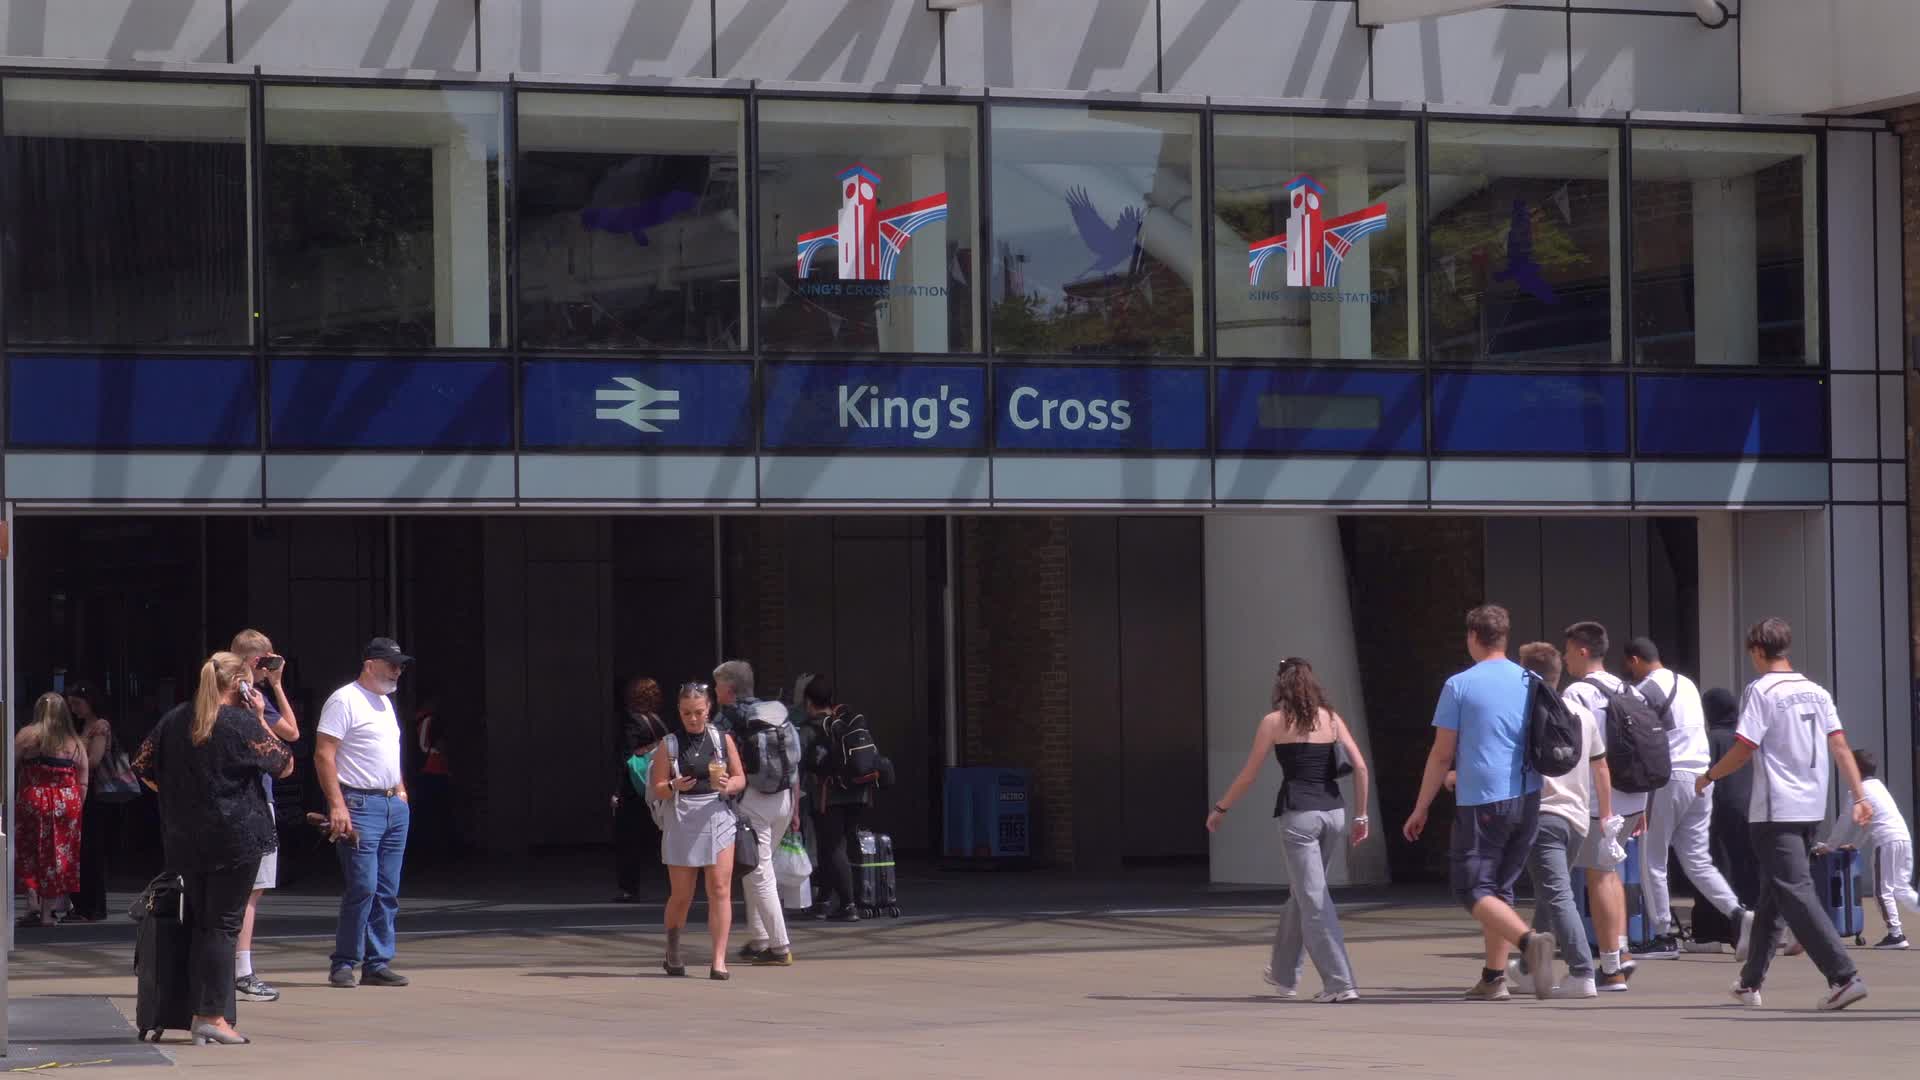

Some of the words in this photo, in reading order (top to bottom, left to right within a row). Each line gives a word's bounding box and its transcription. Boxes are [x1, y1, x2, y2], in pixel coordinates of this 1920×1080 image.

[838, 385, 971, 439] King's
[1009, 386, 1132, 430] Cross
[1800, 713, 1817, 768] 7
